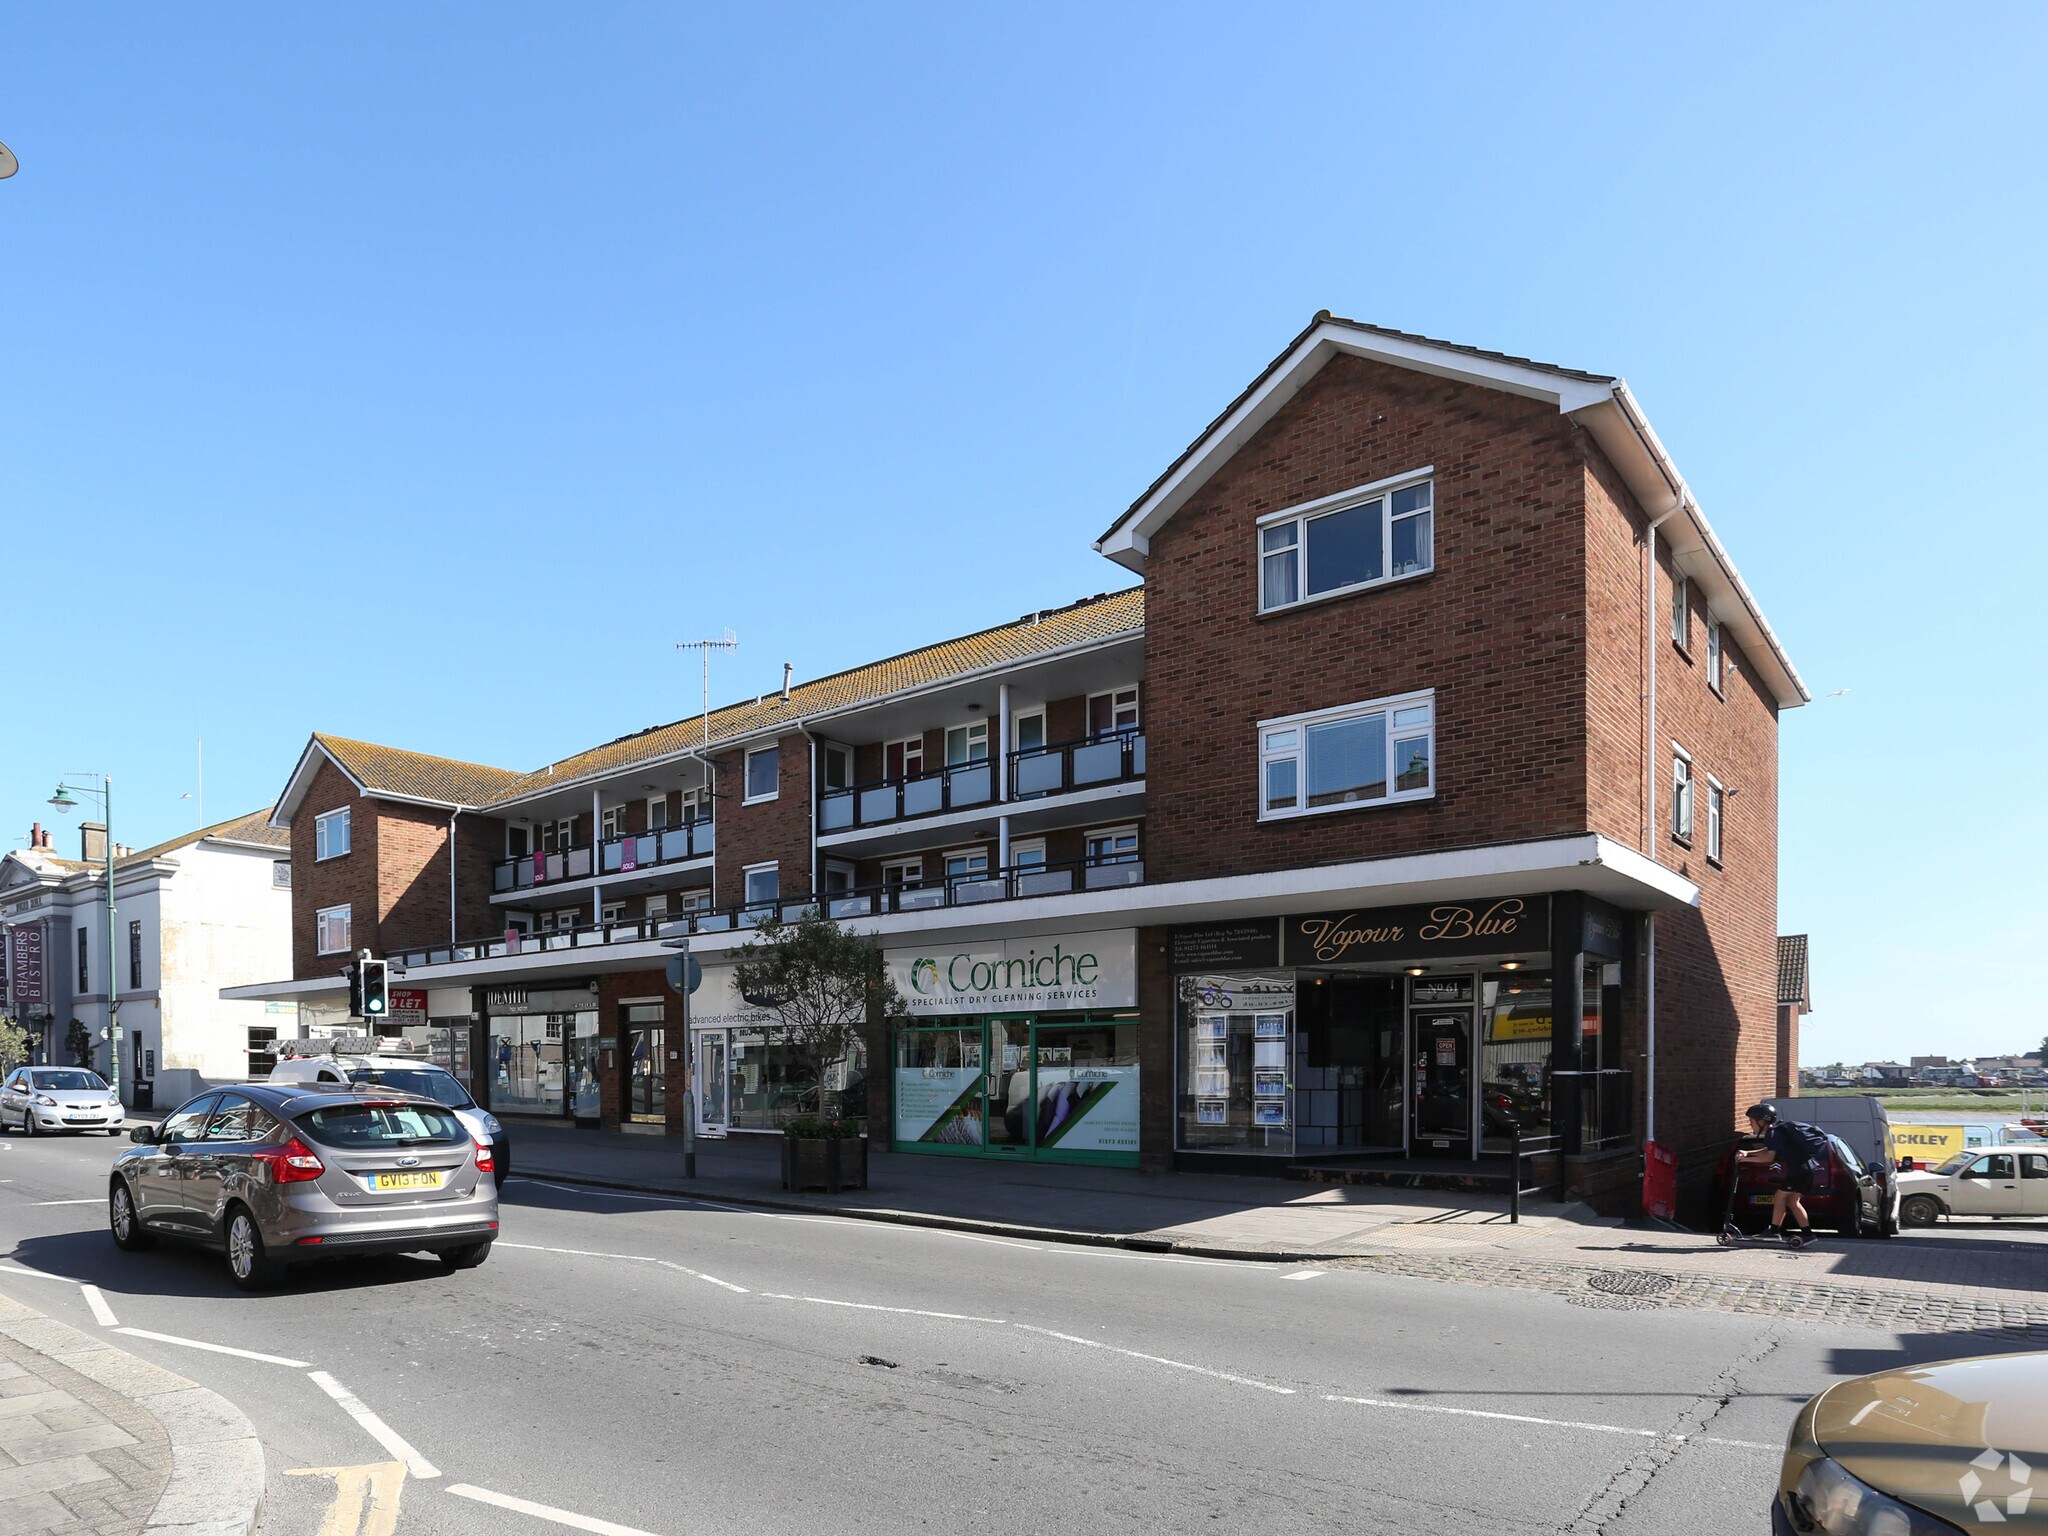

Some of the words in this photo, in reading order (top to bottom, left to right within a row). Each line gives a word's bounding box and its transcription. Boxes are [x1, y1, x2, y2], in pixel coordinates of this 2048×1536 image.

[622, 862, 635, 870] SOLD
[1301, 913, 1404, 962] Vapour
[1419, 898, 1524, 940] Blue
[16, 931, 28, 996] CHAMBERS
[29, 932, 41, 997] BISTRO
[947, 943, 1098, 992] Corniche
[1446, 982, 1458, 992] 61
[399, 999, 421, 1008] LET
[912, 996, 964, 1007] SPECIALIST
[969, 995, 987, 1004] DRY
[992, 992, 1042, 1003] CLEANING
[1047, 989, 1097, 1000] SERVICES
[689, 1014, 721, 1024] advanced
[723, 1013, 749, 1023] electric
[751, 1012, 771, 1022] bikes
[929, 1069, 955, 1078] Corniche
[1077, 1069, 1108, 1078] Corniche
[1892, 1134, 1948, 1146] ACKLEY
[381, 1174, 409, 1187] GV13
[413, 1173, 437, 1185] FON
